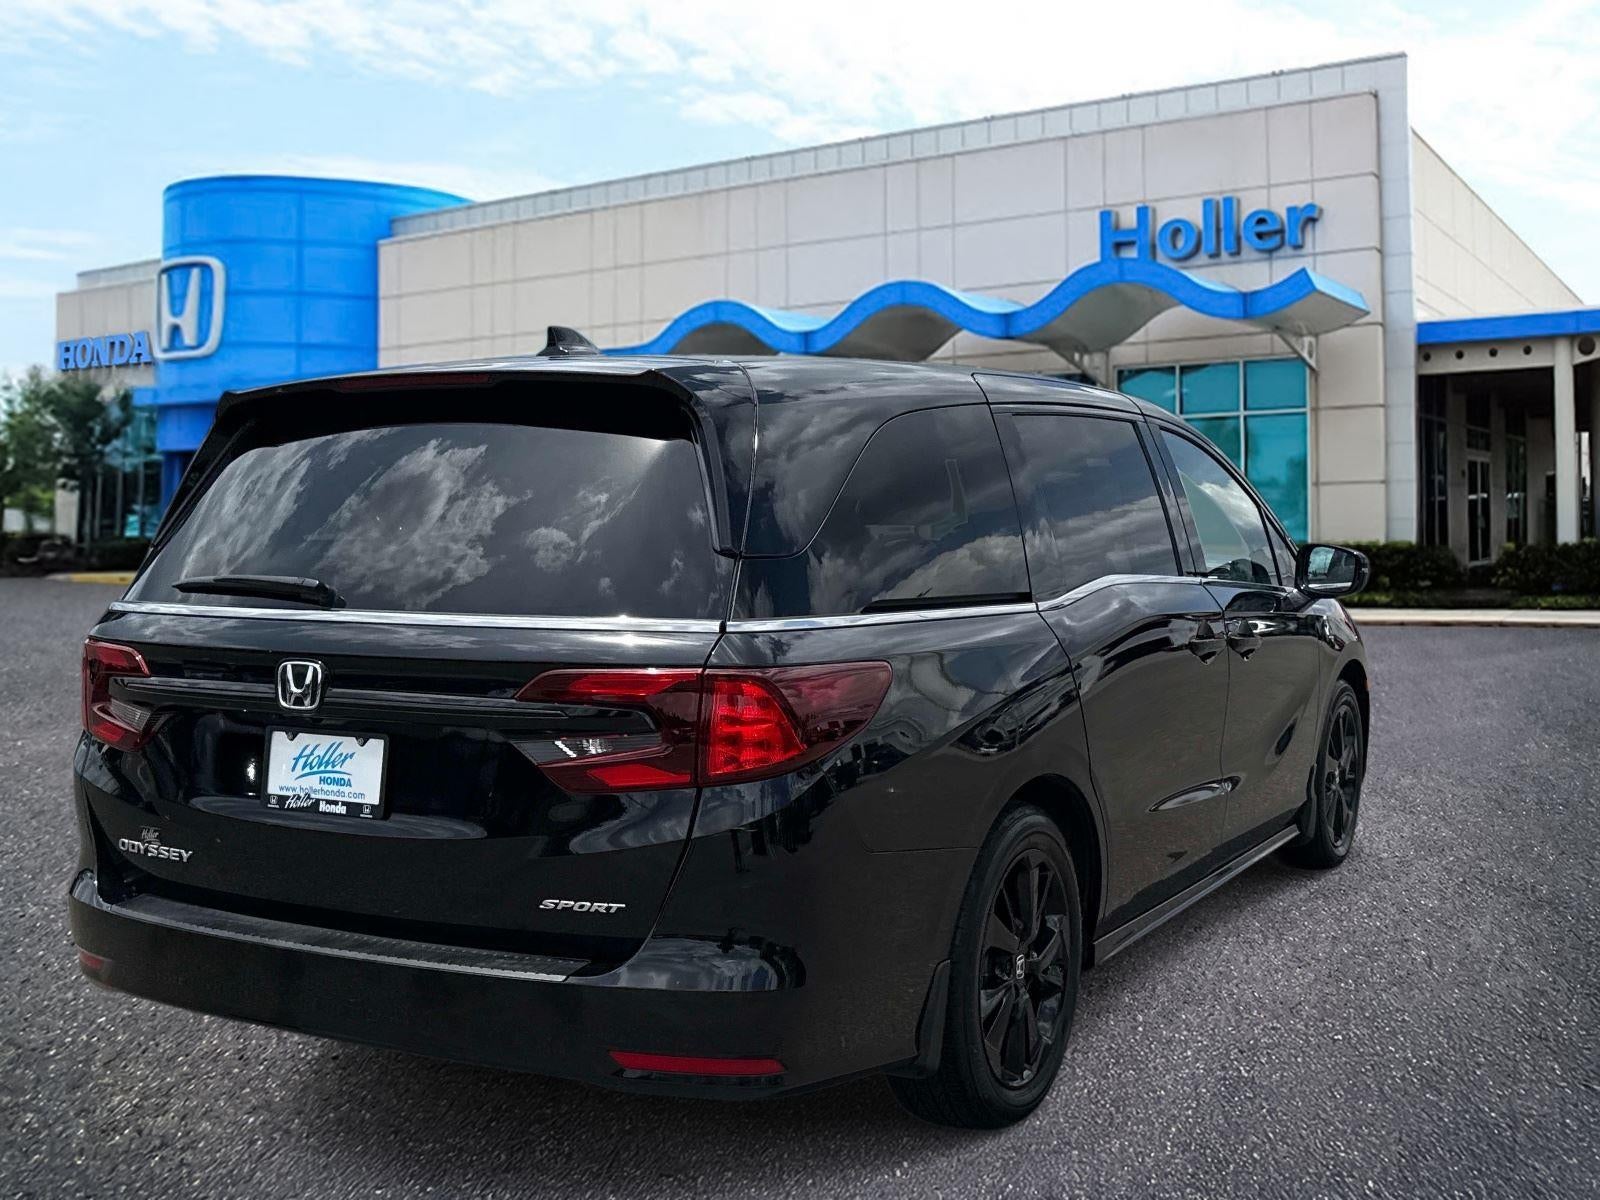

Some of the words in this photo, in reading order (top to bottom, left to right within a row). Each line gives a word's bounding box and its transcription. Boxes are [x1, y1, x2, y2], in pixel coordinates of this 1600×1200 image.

[1099, 196, 1321, 262] Holler
[57, 331, 152, 370] HONDA
[291, 741, 356, 772] Holler
[278, 784, 366, 800] www.hollerhonda.com
[319, 775, 352, 788] HONDA
[284, 793, 316, 809] Holler
[319, 800, 347, 815] Honda
[118, 838, 193, 862] ODYSSEY
[539, 899, 626, 913] SPORT
